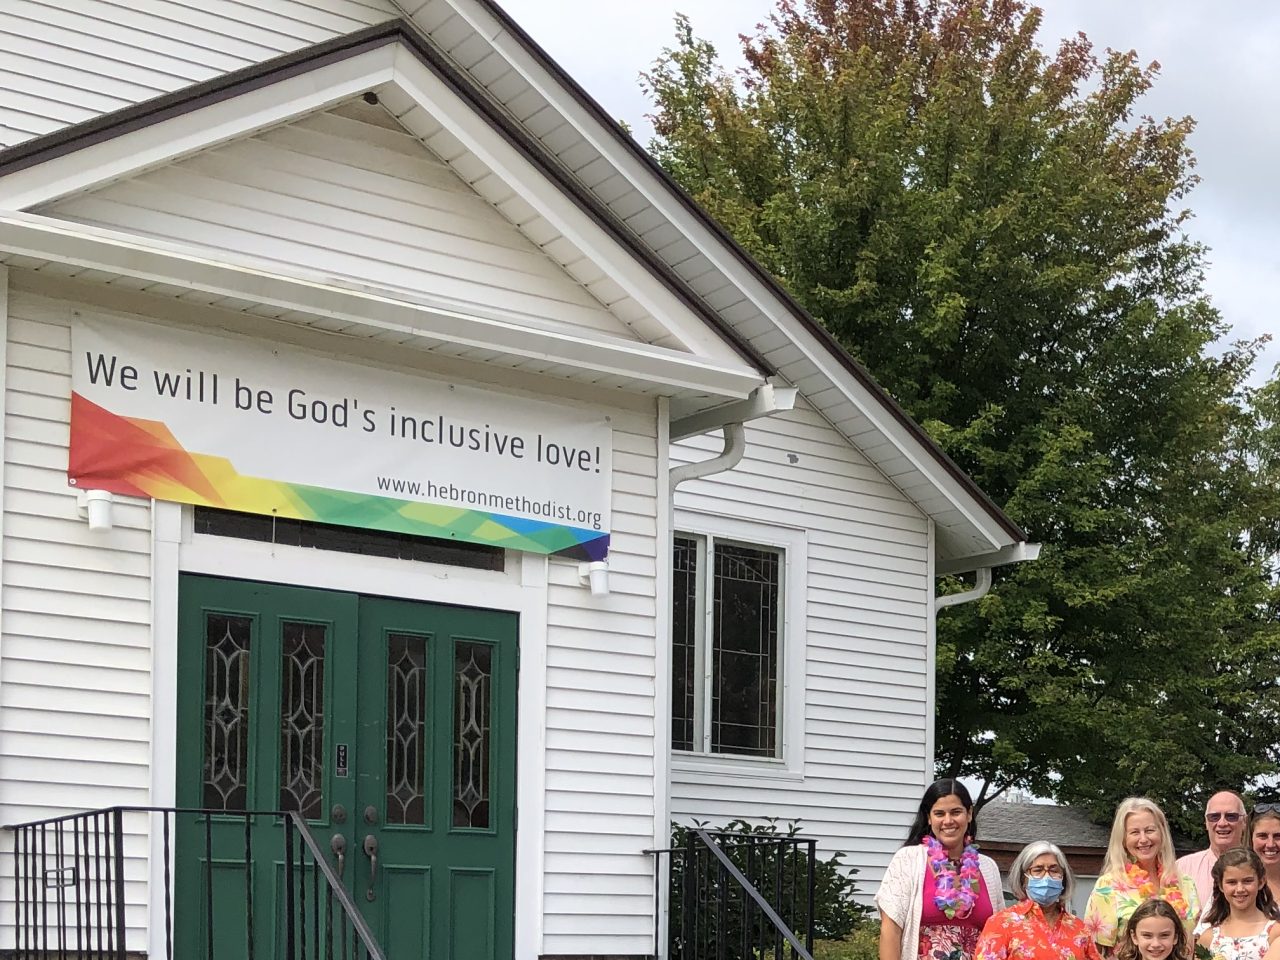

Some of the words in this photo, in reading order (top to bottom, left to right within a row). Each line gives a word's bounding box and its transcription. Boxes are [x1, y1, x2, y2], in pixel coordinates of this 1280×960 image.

[86, 351, 138, 391] We
[153, 368, 218, 405] will
[234, 378, 274, 415] be
[288, 390, 376, 433] God's
[390, 407, 525, 459] inclusive
[537, 434, 601, 474] love!
[377, 473, 602, 530] www.hebronmethodist.org
